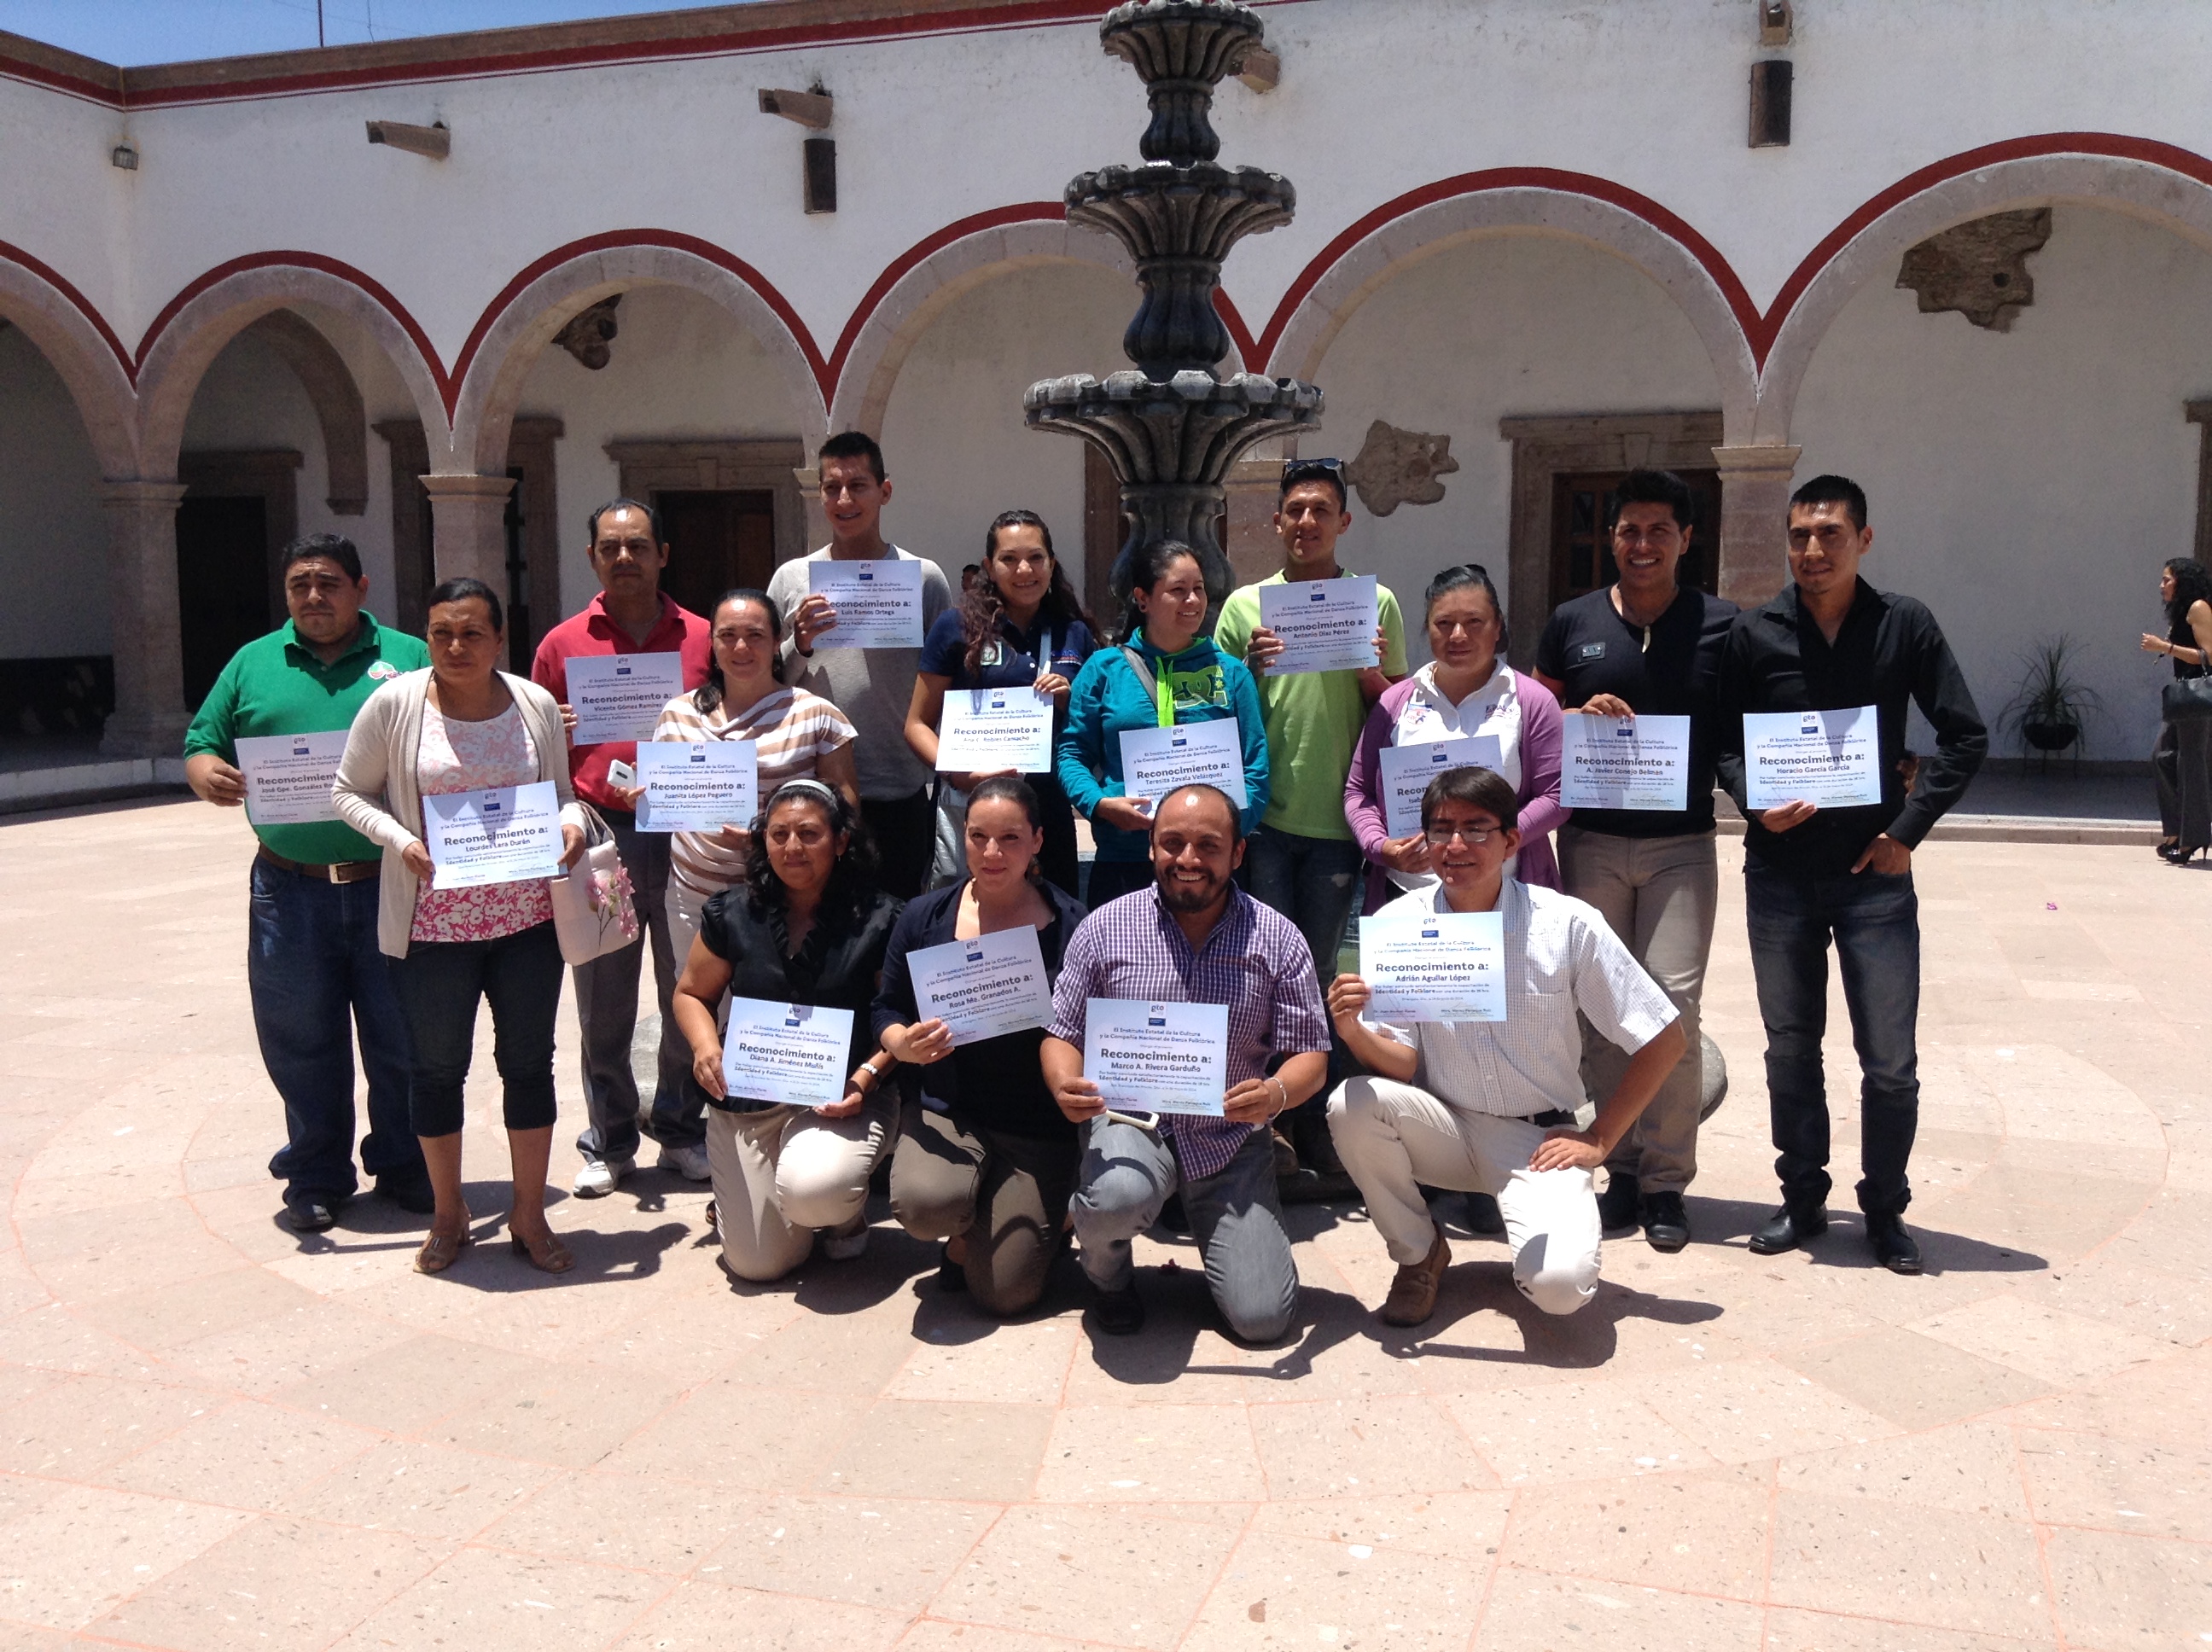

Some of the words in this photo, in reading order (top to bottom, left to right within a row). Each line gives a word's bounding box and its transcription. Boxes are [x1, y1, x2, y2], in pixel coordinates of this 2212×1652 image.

[1274, 619, 1355, 633] Reconocimiento
[582, 693, 661, 704] Reconocimiento
[1576, 756, 1662, 766] Reconocimiento
[1759, 755, 1852, 765] Reconocimiento
[1137, 763, 1218, 779] Reconocimiento
[257, 773, 337, 785] Reconocimient
[651, 782, 734, 791] Reconocimiento
[444, 828, 536, 846] Reconocimiento
[466, 843, 492, 852] Lourdes
[1376, 962, 1474, 972] Reconocimiento
[931, 976, 1021, 1003] Reconocimiento
[949, 999, 965, 1009] Rosa
[981, 989, 1012, 1001] Granados
[739, 1043, 824, 1060] Reconocimiento
[1101, 1048, 1198, 1063] Reconocimiento
[1201, 1055, 1212, 1063] a:
